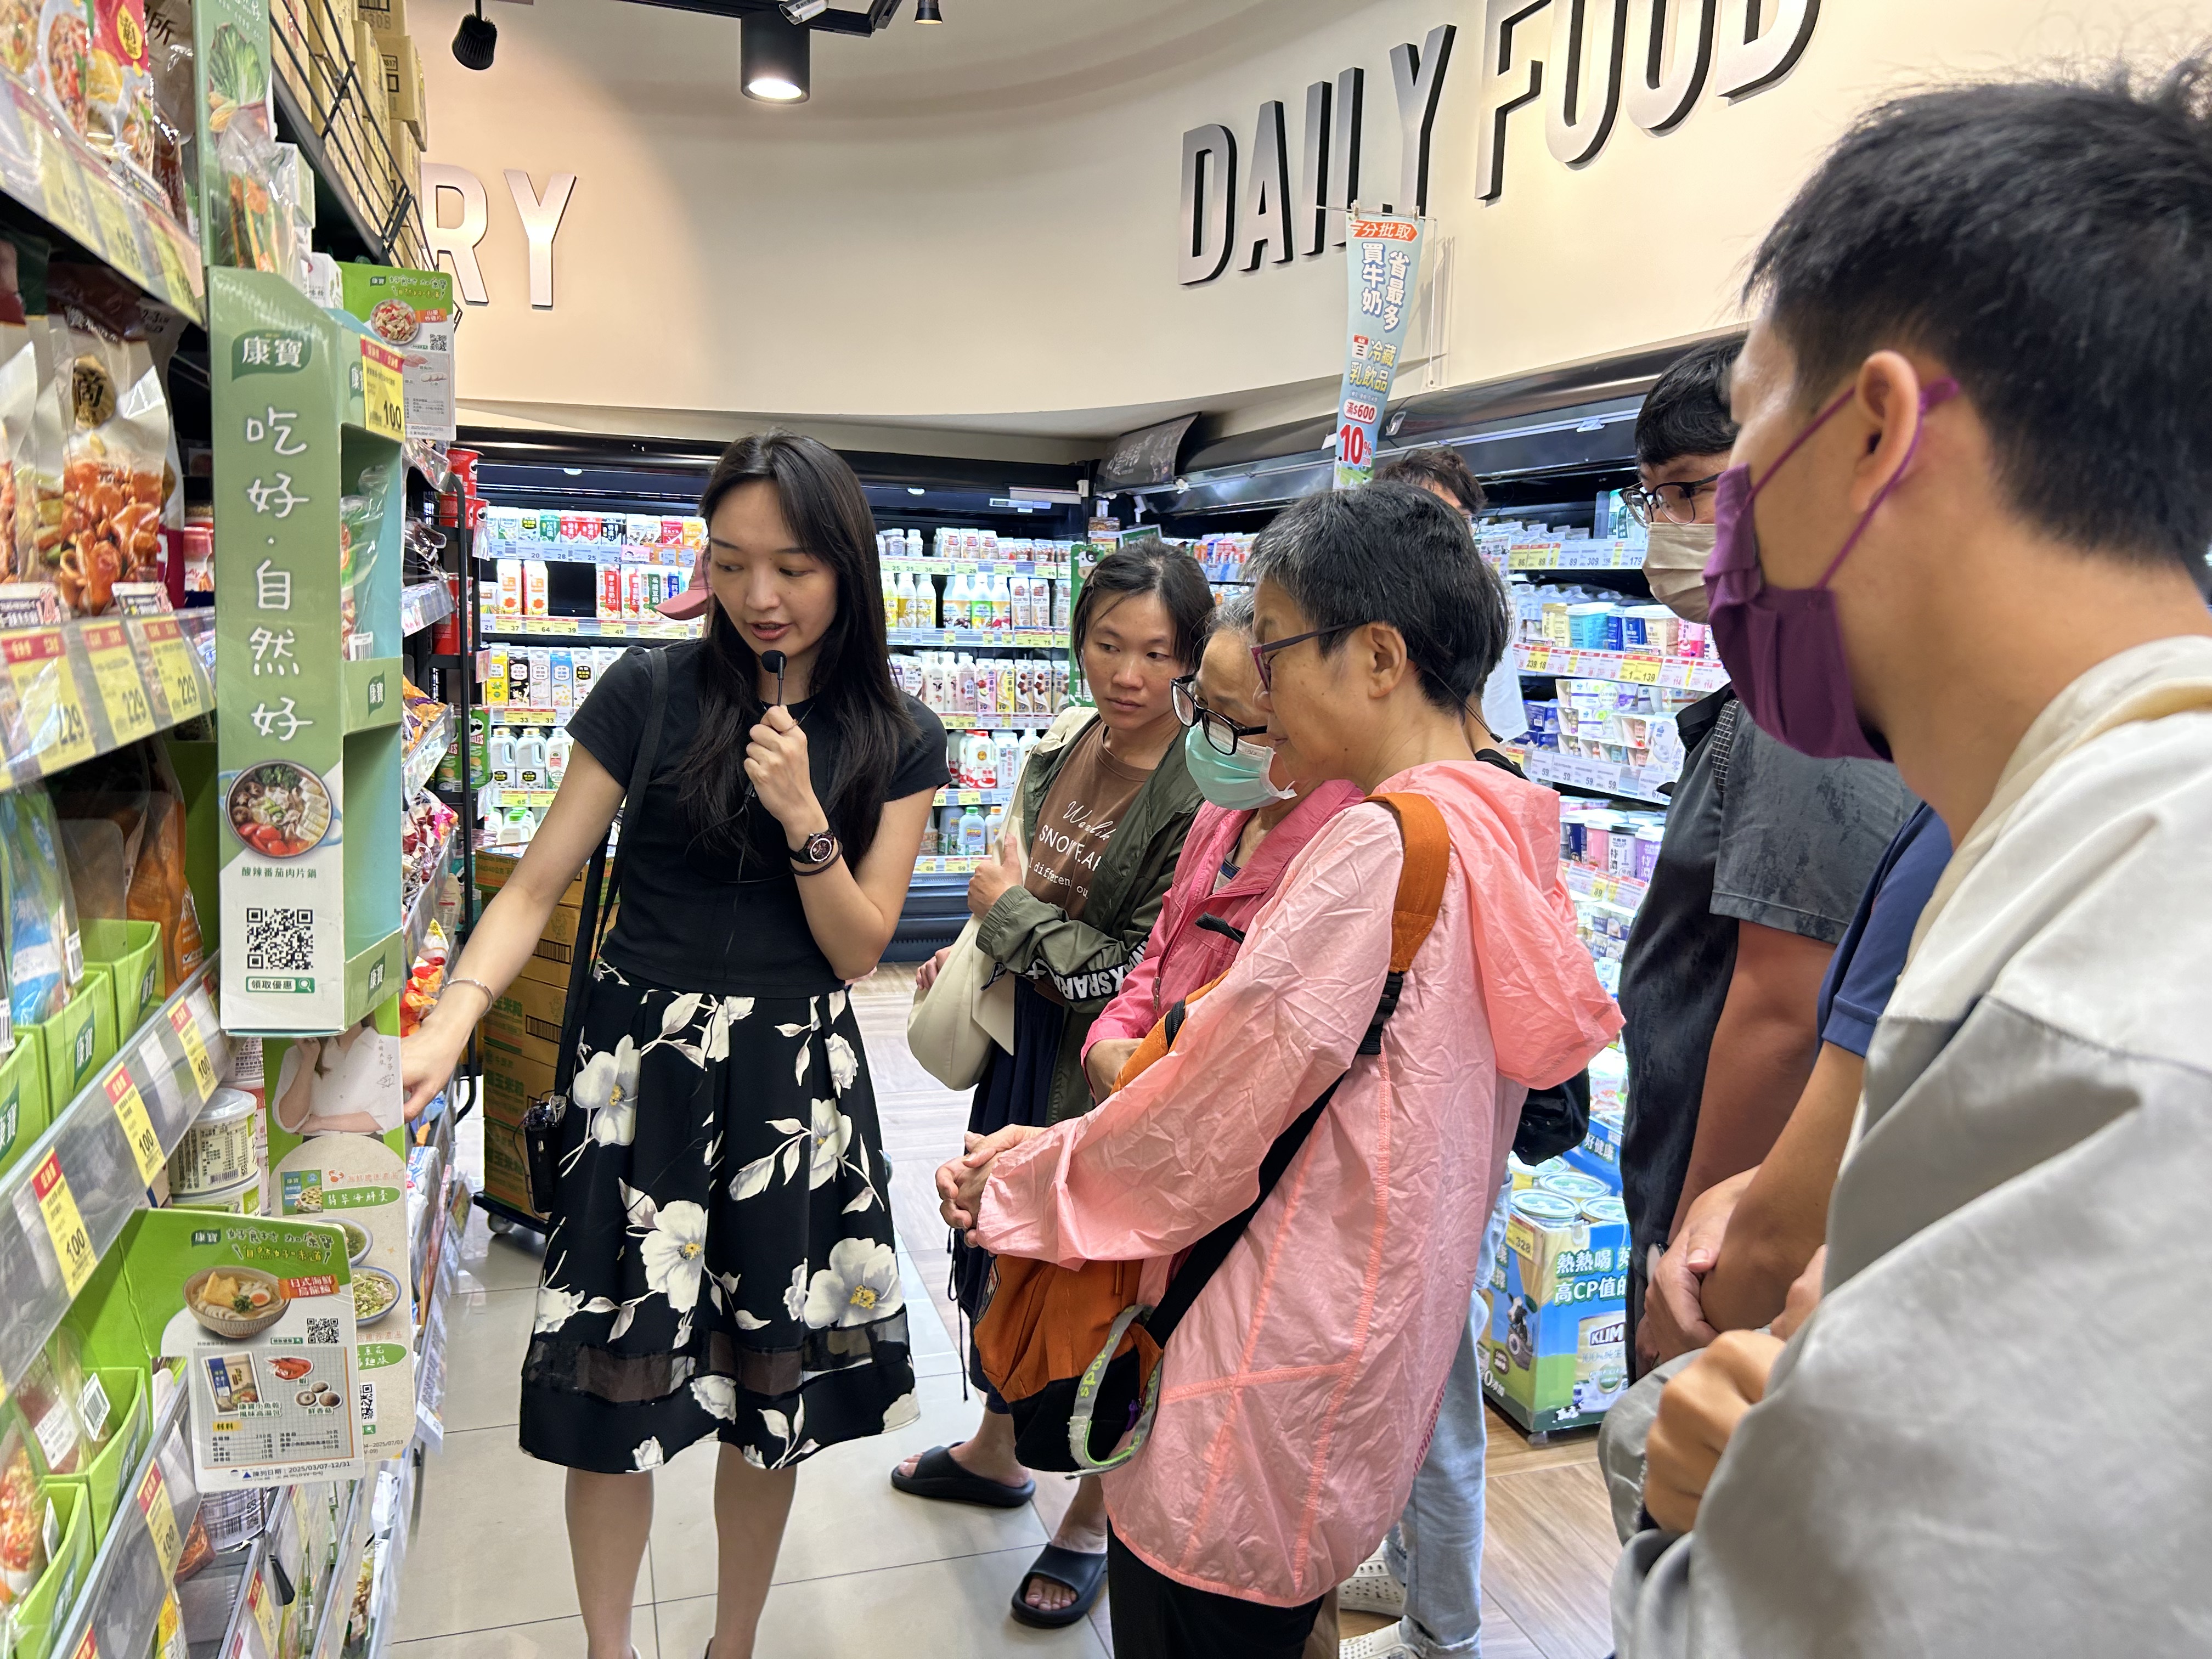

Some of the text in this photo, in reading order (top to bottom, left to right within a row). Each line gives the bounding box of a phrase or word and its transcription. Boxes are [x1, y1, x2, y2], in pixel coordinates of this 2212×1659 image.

[1178, 22, 1457, 286] DAILY
[420, 162, 577, 310] RY
[1361, 223, 1412, 240] 分批取
[1362, 242, 1385, 316] 買牛奶
[1384, 250, 1410, 332] 省最多
[242, 335, 302, 368] 康寶
[1368, 340, 1397, 368] 冷藏
[1349, 362, 1389, 393] 乳飲品
[383, 400, 402, 430] 100
[1339, 424, 1372, 465] 10%
[1630, 557, 1642, 566] 179
[1526, 660, 1537, 669] 239
[1643, 673, 1655, 682] 139
[177, 674, 197, 707] 229
[369, 682, 383, 703] 康寶
[1542, 768, 1549, 776] 59
[1563, 772, 1571, 781] 59
[1585, 776, 1593, 785] 59
[1608, 781, 1616, 789] 59
[241, 866, 317, 879] 酸辣番茄肉片鍋
[251, 979, 292, 989] 領取優惠
[370, 963, 384, 989] 康寶
[76, 1027, 93, 1068] 康寶
[198, 1055, 211, 1079] 100
[138, 1128, 154, 1156] 100
[1585, 1132, 1615, 1163] 好健康
[66, 1227, 86, 1263] 100
[1556, 1249, 1612, 1274] 熱熱喝
[290, 1275, 333, 1288] 日式海鮮
[1592, 1323, 1624, 1344] KLIM
